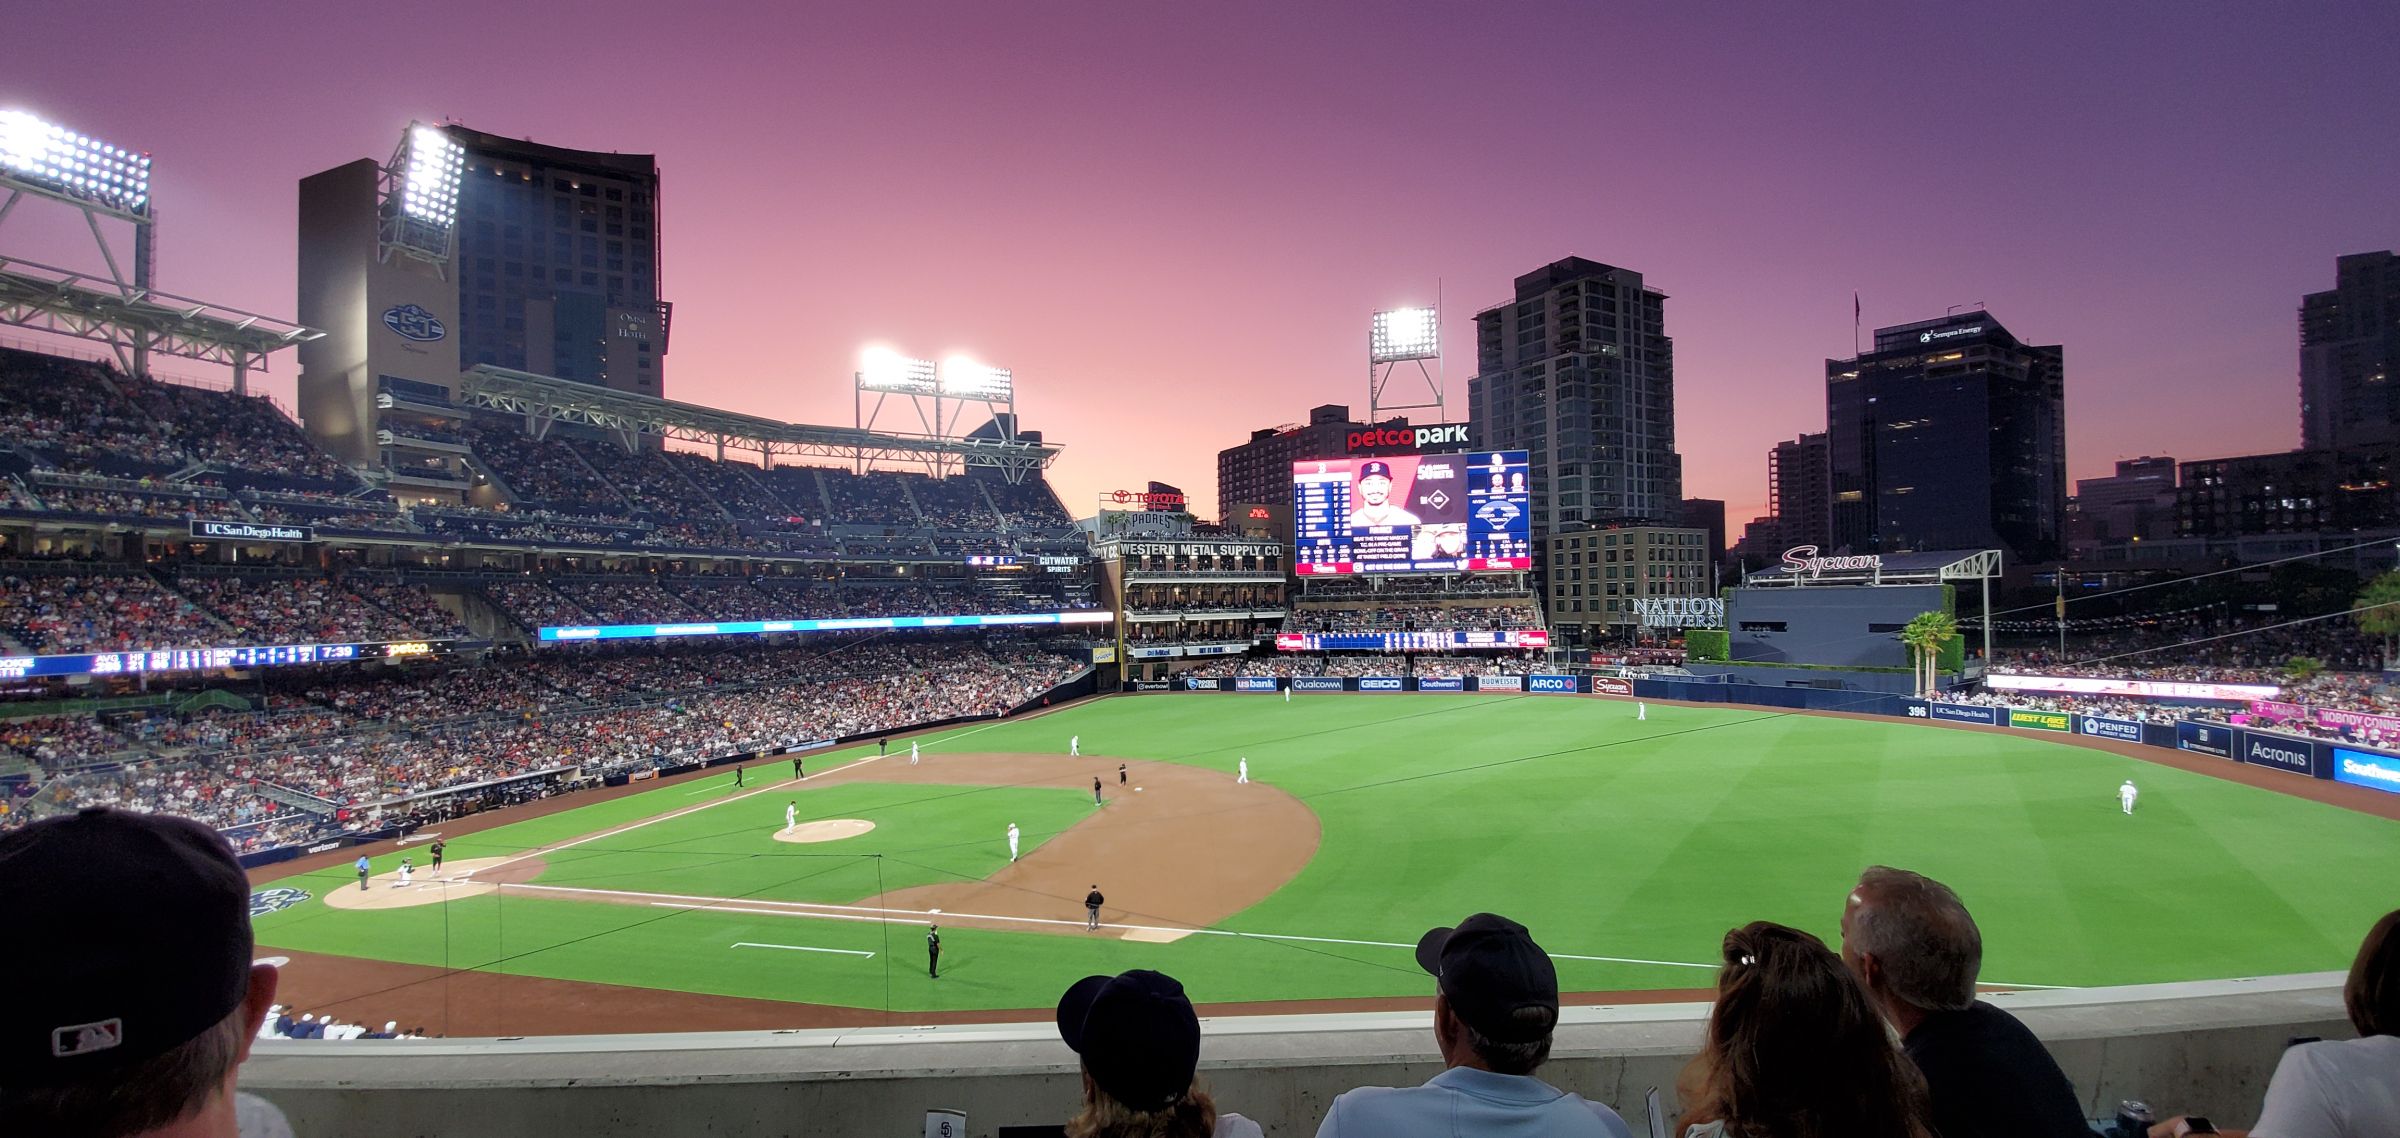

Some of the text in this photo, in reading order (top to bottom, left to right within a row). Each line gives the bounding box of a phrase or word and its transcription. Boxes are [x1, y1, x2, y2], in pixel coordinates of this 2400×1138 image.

[1933, 326, 1982, 338] Sempra Energy
[1135, 492, 1184, 505] TOYOTA
[1132, 513, 1170, 528] PADRES
[205, 523, 303, 538] UC San Diego Health
[1120, 543, 1282, 556] WESTERN METAL SUPPLY CO.
[1039, 556, 1079, 565] CUTWATER
[1781, 545, 1883, 578] Sycuan
[1632, 598, 1724, 615] NATION
[1641, 614, 1724, 627] UNIVERSI
[129, 652, 145, 661] HR
[323, 645, 352, 657] 7:39
[1294, 680, 1340, 689] Qualcomm
[1361, 680, 1400, 688] GEICO
[1531, 679, 1563, 689] ARCO
[1597, 679, 1628, 693] Sycuan
[1908, 706, 1926, 717] 396
[1955, 709, 1971, 717] Diego
[2012, 713, 2068, 725] WEST LAKE
[2321, 711, 2364, 725] NOBODY
[2100, 722, 2138, 734] PENFED
[2251, 742, 2306, 766] Acronis
[309, 841, 339, 854] verizon
